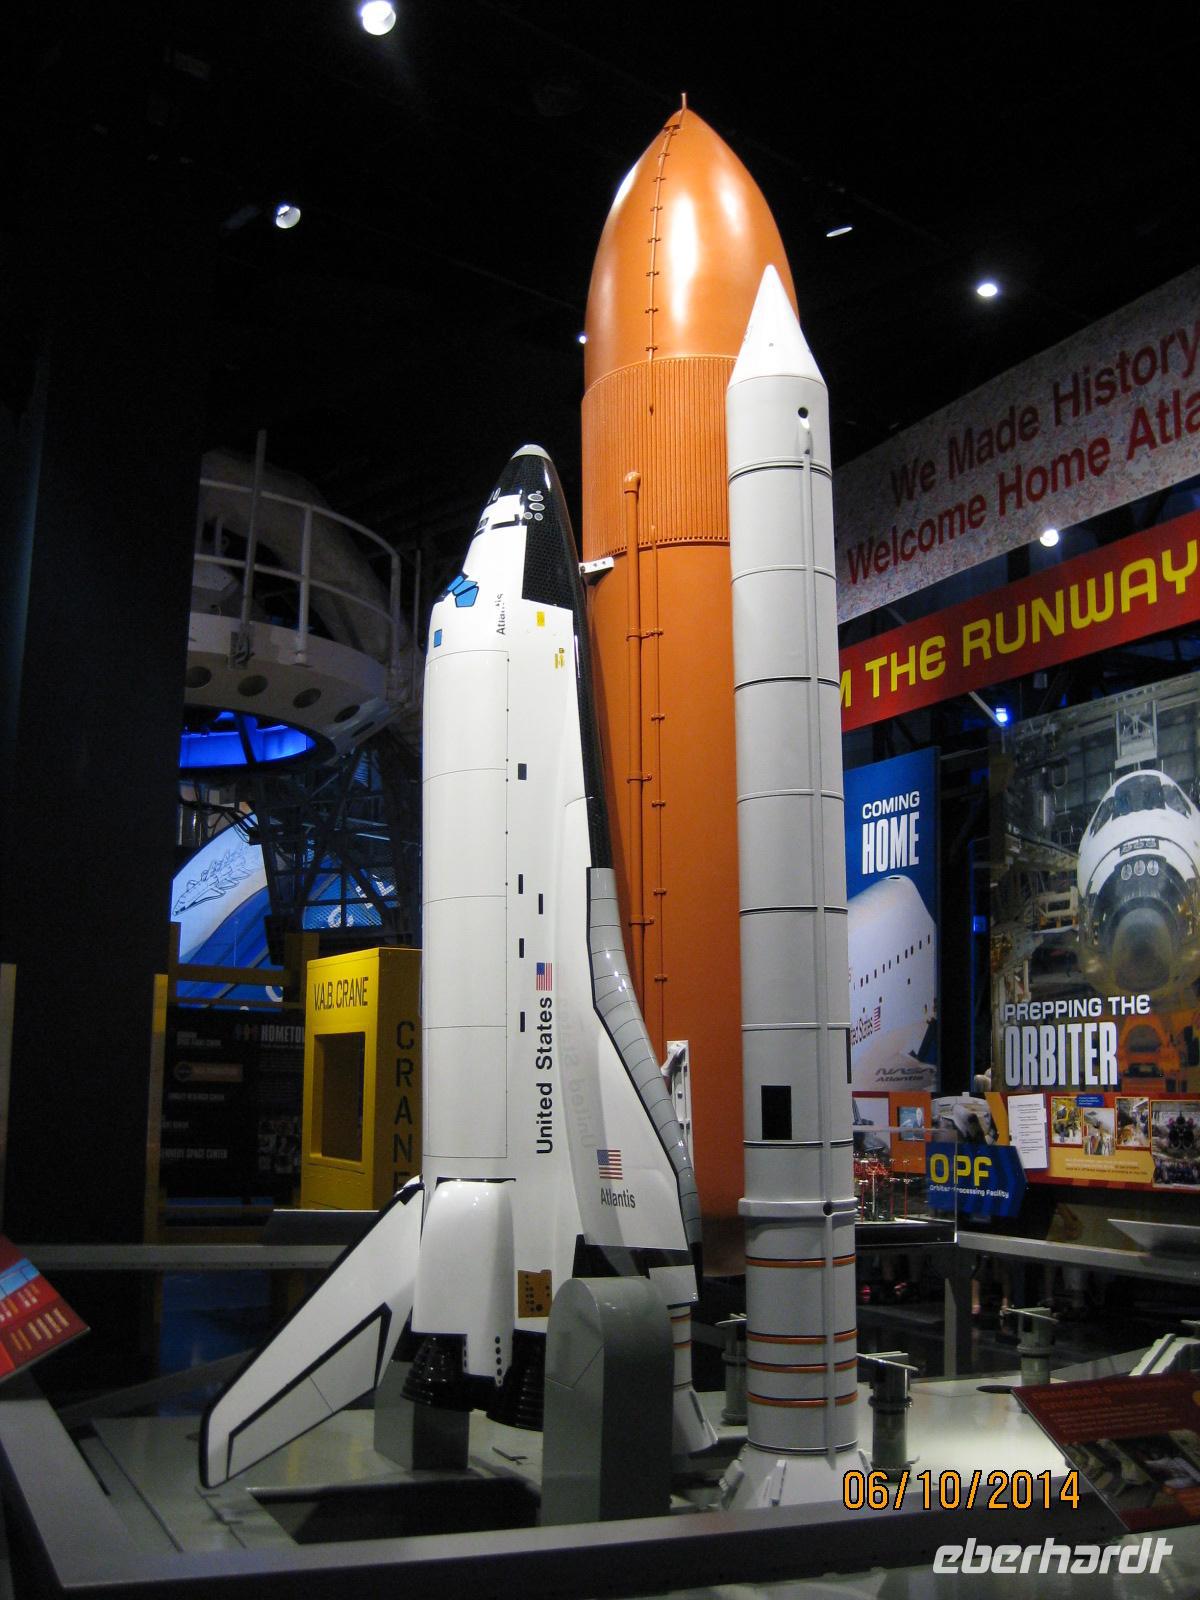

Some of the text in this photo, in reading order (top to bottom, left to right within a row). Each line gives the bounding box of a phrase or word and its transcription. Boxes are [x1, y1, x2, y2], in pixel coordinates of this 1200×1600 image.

[891, 319, 1200, 507] We Made History
[847, 494, 987, 585] Welcome
[998, 437, 1110, 516] Home
[865, 635, 947, 698] THE
[962, 539, 1198, 668] RUNWAY
[862, 791, 920, 819] COMING
[862, 811, 919, 875] HOME
[336, 976, 369, 1009] CRANE
[1005, 994, 1151, 1021] PREPPING THE
[261, 1025, 304, 1043] HOMETO
[1005, 1022, 1119, 1087] ORBITER
[536, 997, 552, 1154] United States
[930, 1153, 992, 1187] OPF
[601, 1187, 636, 1209] Atlantis
